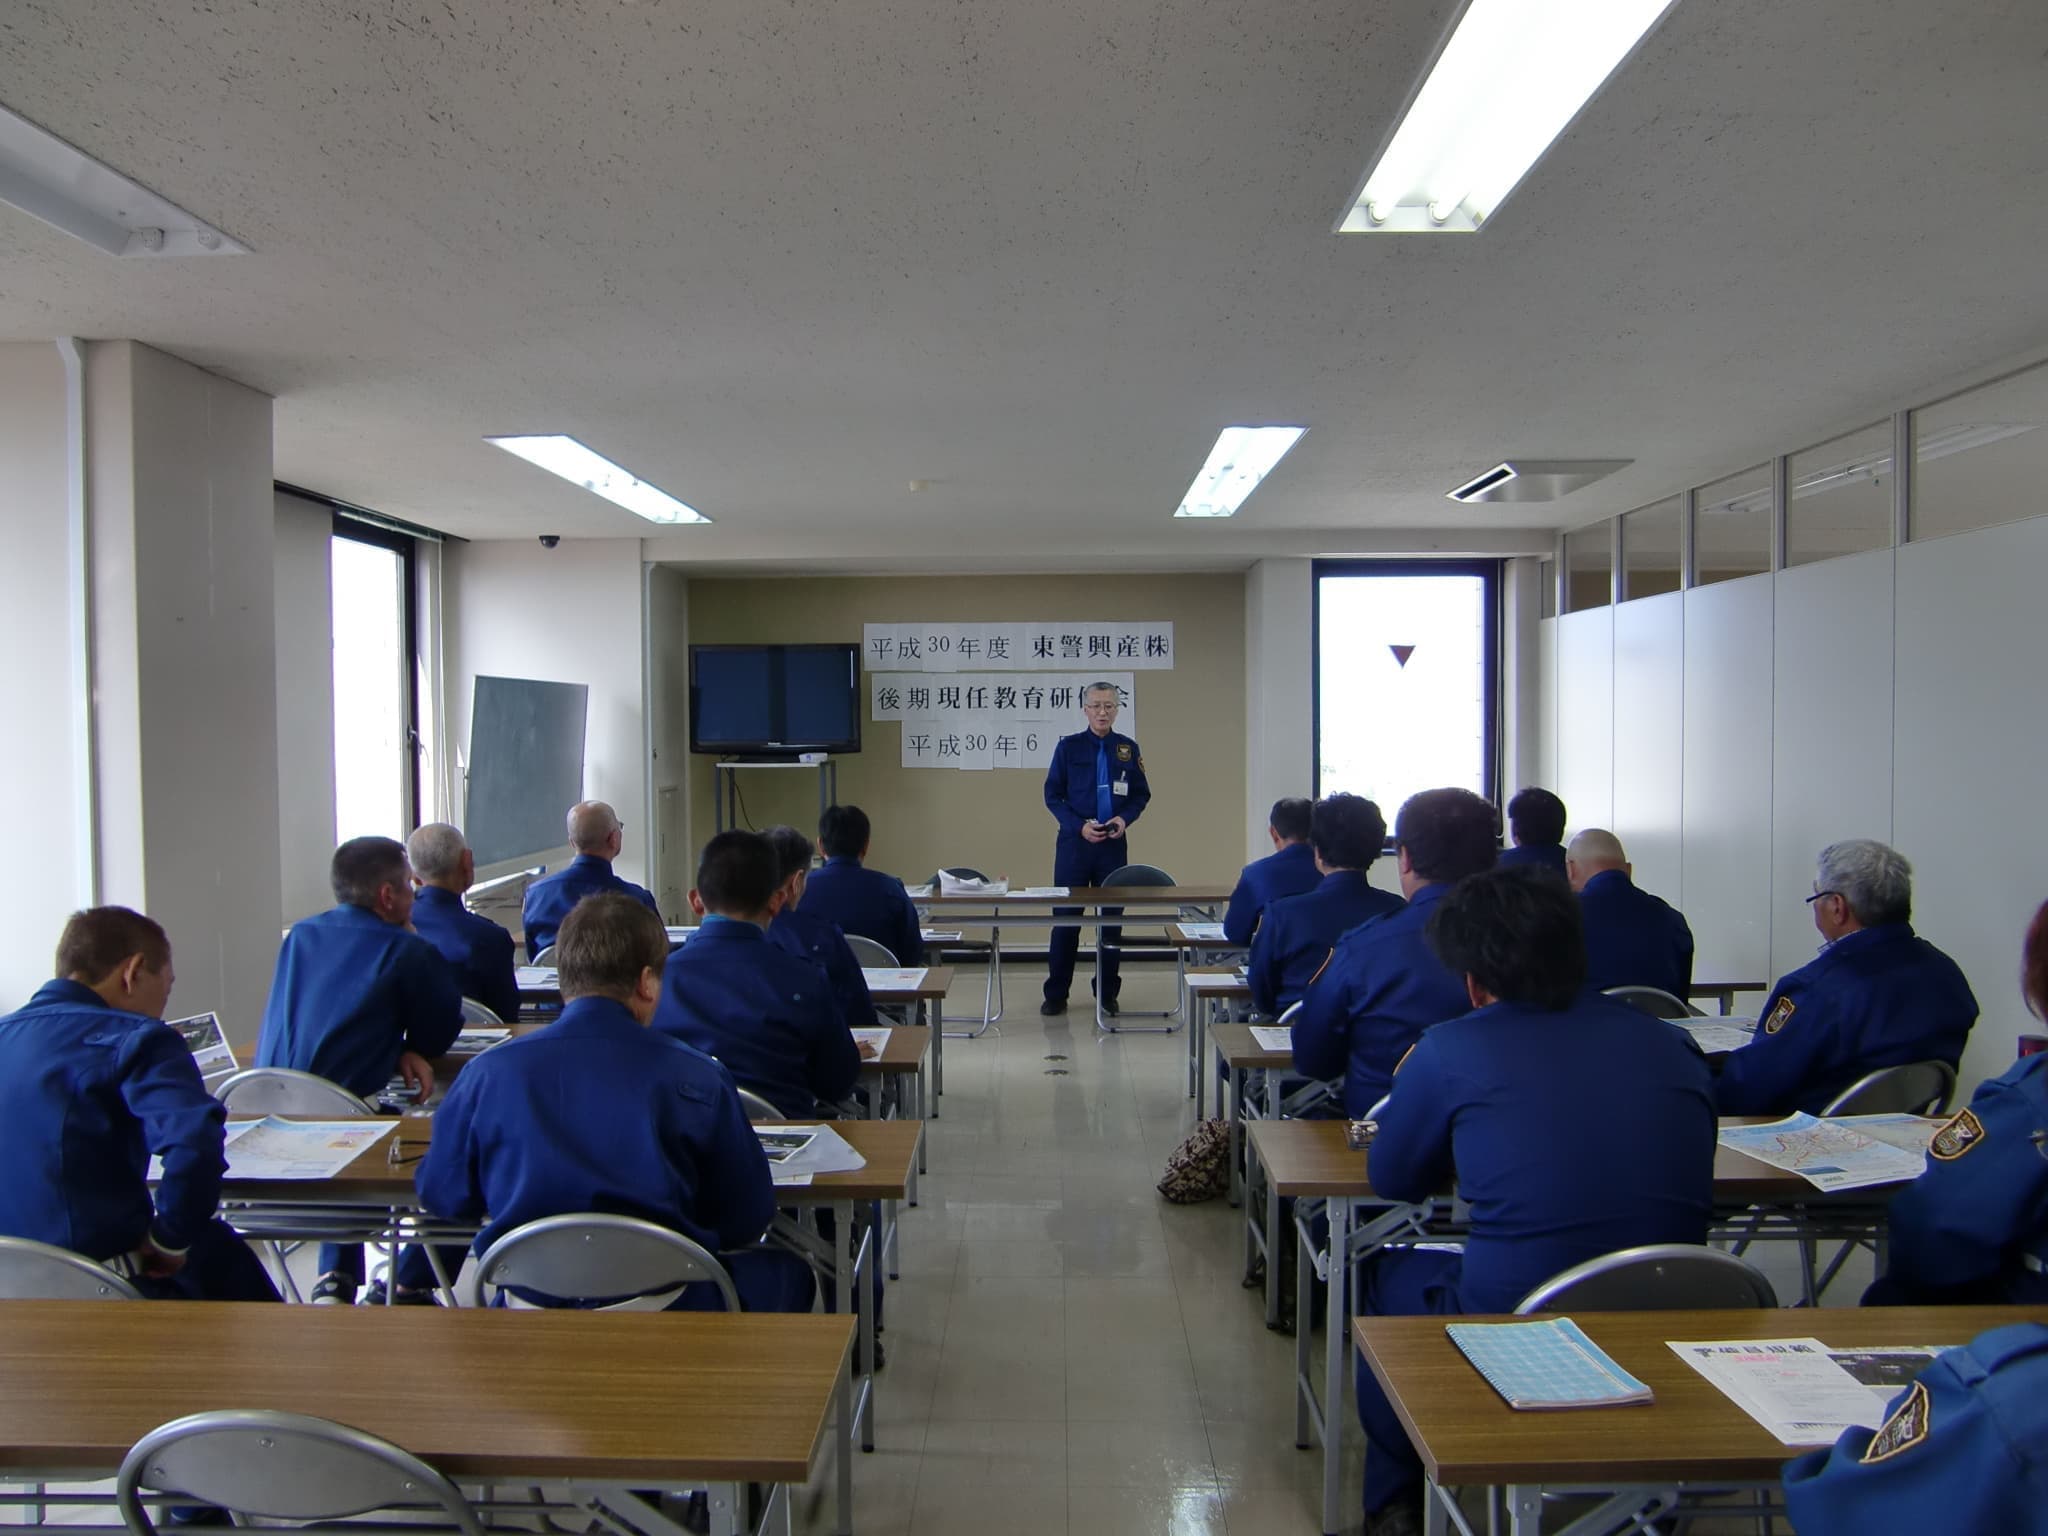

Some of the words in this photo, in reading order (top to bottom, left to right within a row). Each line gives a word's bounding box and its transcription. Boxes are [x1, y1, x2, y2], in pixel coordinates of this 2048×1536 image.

[870, 635, 1010, 660] 平成30年度
[907, 733, 1066, 758] 平成30年6
